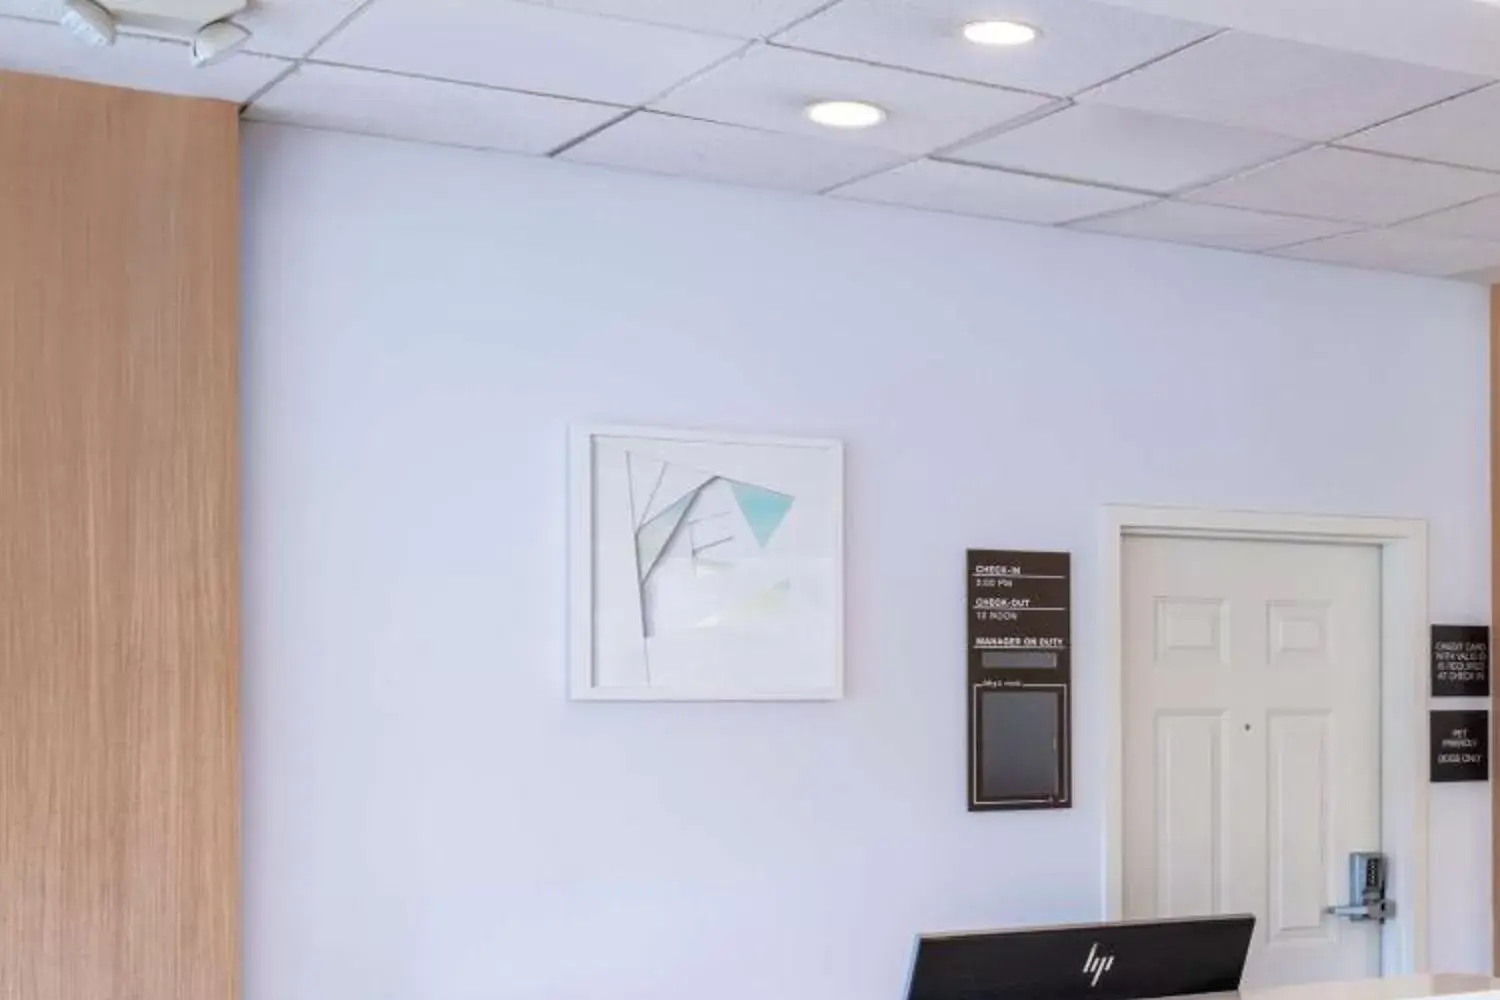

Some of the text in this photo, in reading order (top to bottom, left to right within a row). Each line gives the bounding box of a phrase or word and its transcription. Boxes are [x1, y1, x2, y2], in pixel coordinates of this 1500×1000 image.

[975, 565, 1021, 575] CHECK-IN
[975, 597, 1031, 608] CHECK-OUT
[976, 637, 1064, 647] MANAGER ON DUTY
